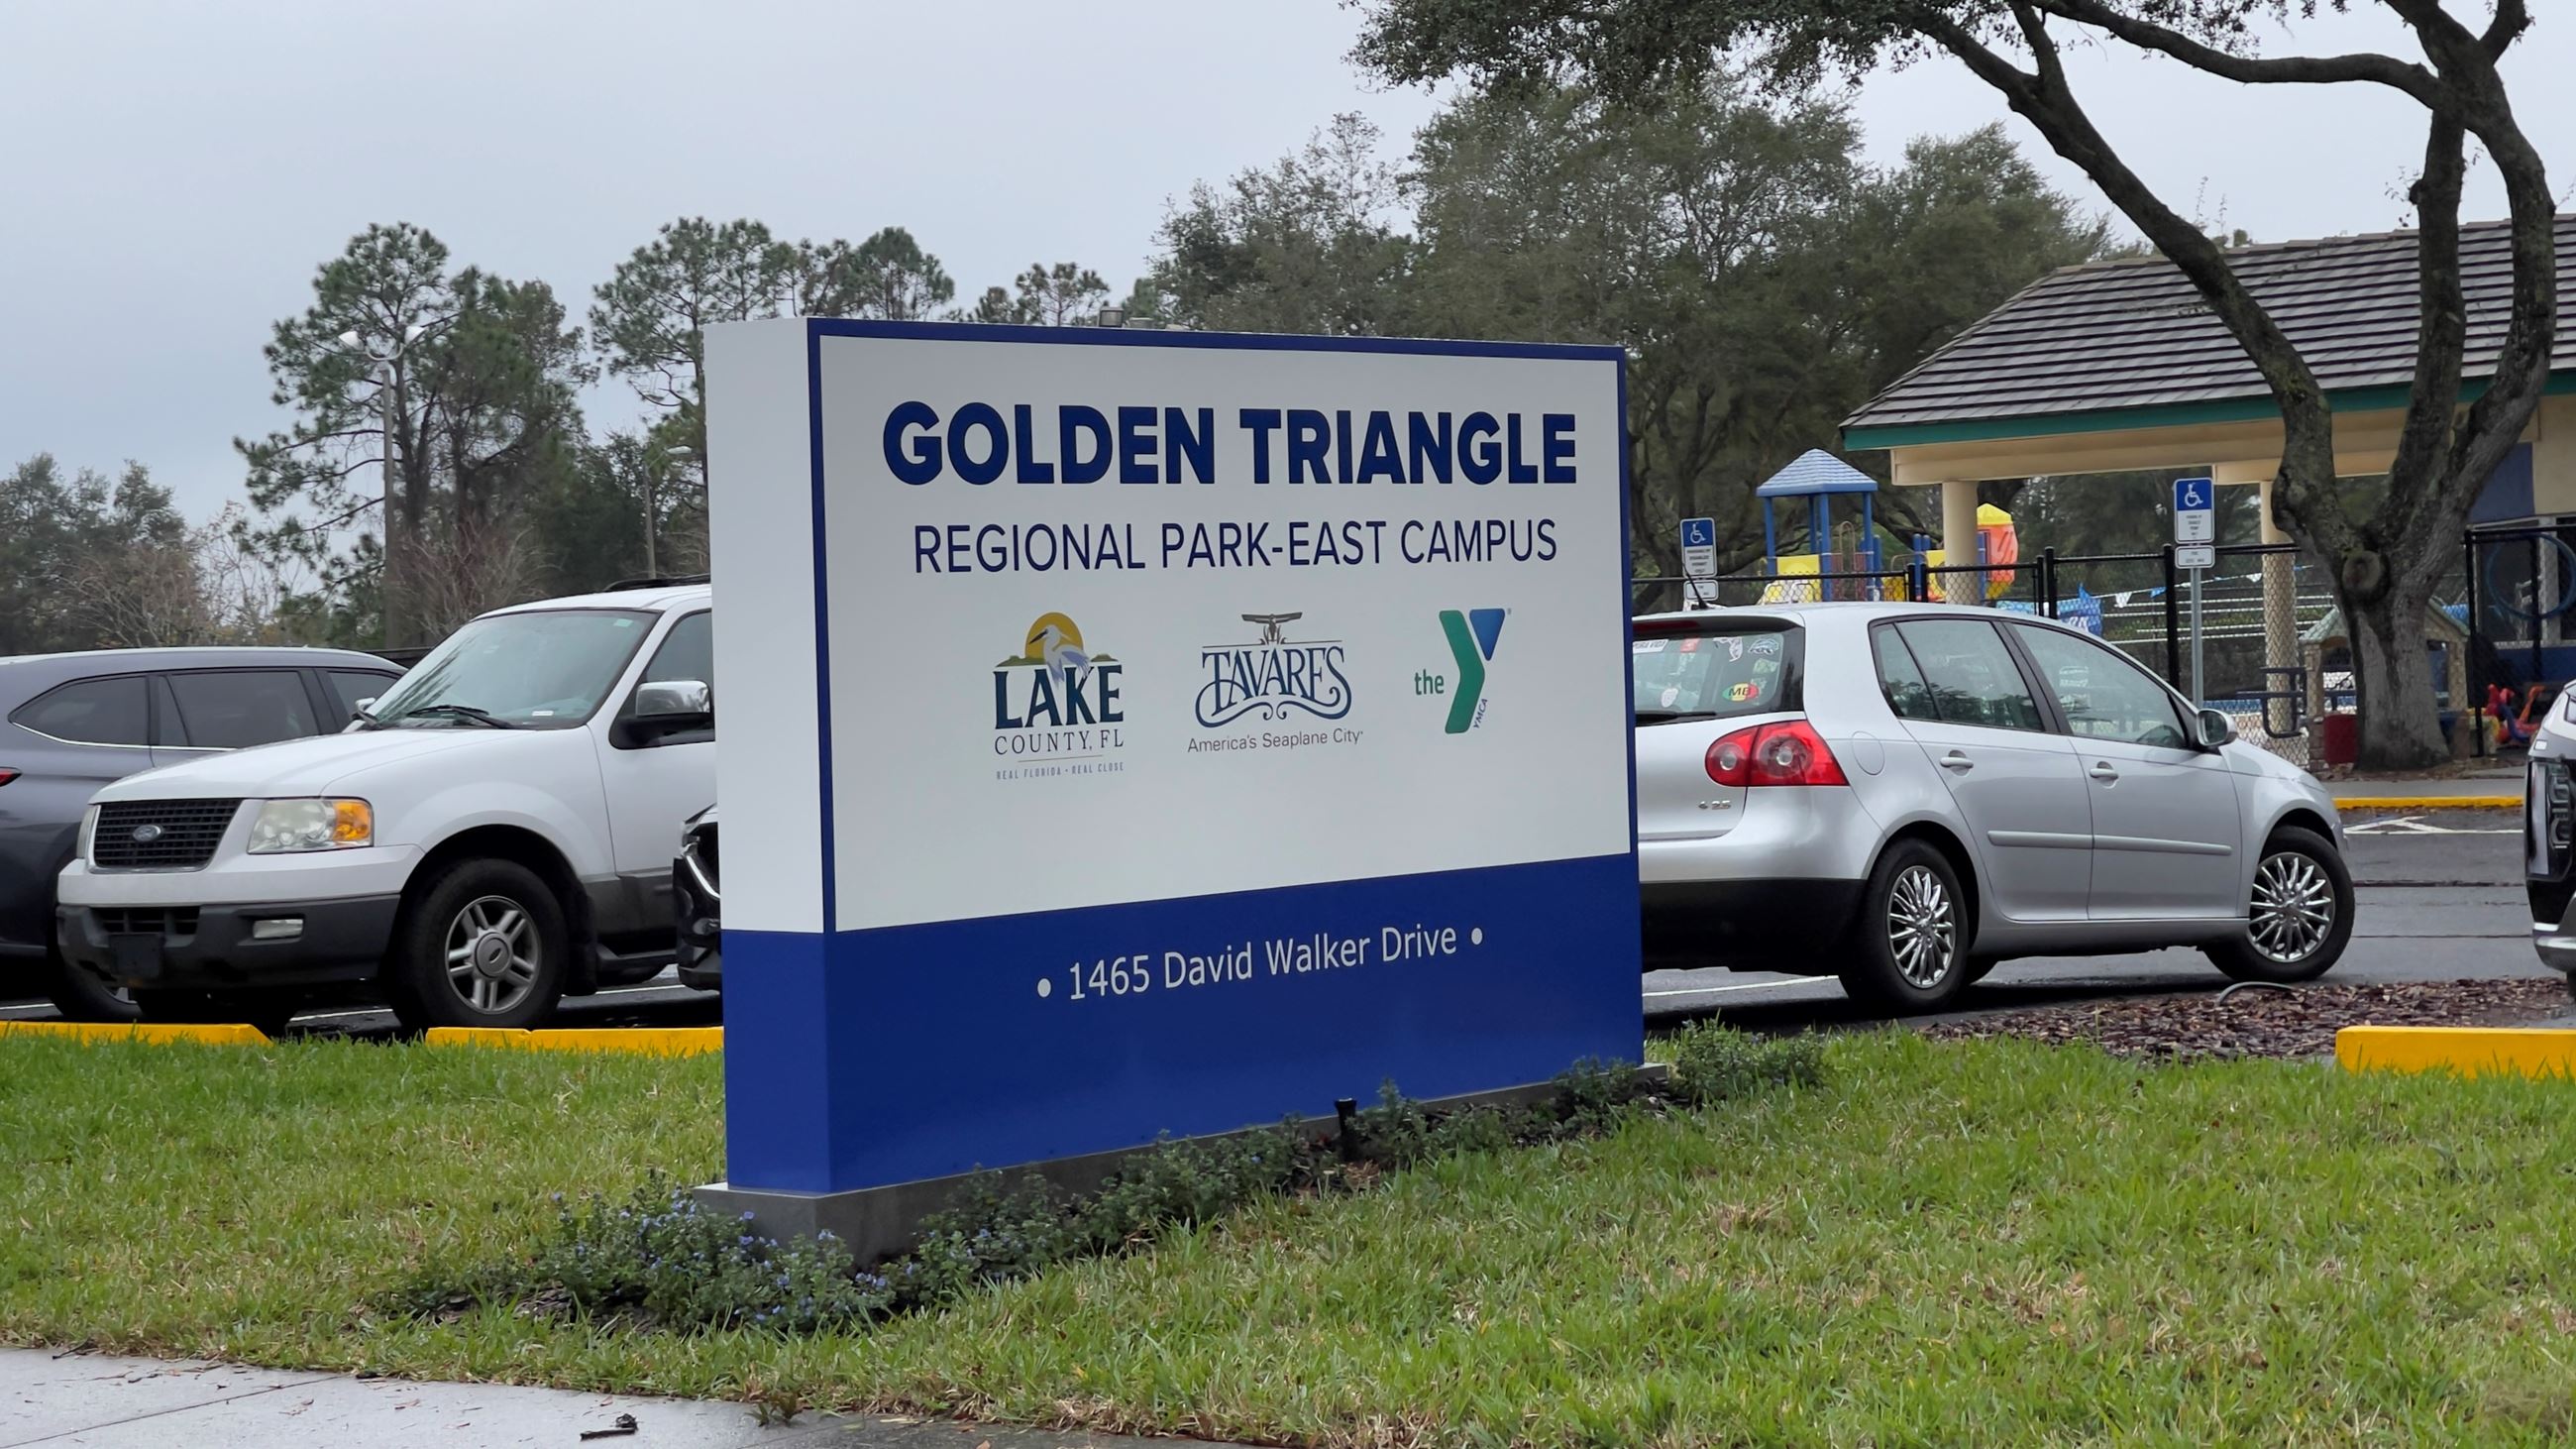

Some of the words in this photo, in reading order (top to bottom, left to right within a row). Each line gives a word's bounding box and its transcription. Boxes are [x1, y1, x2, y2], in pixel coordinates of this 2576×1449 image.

[883, 400, 1216, 487] GOLDEN
[1239, 407, 1577, 486] TRIANGLE
[915, 523, 1146, 574] REGIONAL
[1162, 520, 1387, 569] PARK-EAST
[1401, 518, 1557, 564] CAMPUS
[993, 664, 1125, 730] LAKE
[1195, 645, 1352, 728] TAVARES
[1414, 668, 1445, 696] the
[1472, 698, 1488, 730] YMCA
[994, 729, 1093, 756] COUNTY,
[1100, 728, 1125, 748] FL
[1188, 735, 1257, 753] America's
[1262, 730, 1329, 750] Seaplane
[997, 768, 1020, 781] REAL
[1023, 766, 1062, 778] FLORIDA
[1071, 764, 1094, 775] REAL
[1097, 762, 1125, 773] CLOSE
[1070, 954, 1150, 1000] 1465
[1164, 942, 1252, 989] David
[1265, 933, 1370, 975] Walker
[1382, 923, 1456, 962] Drive
